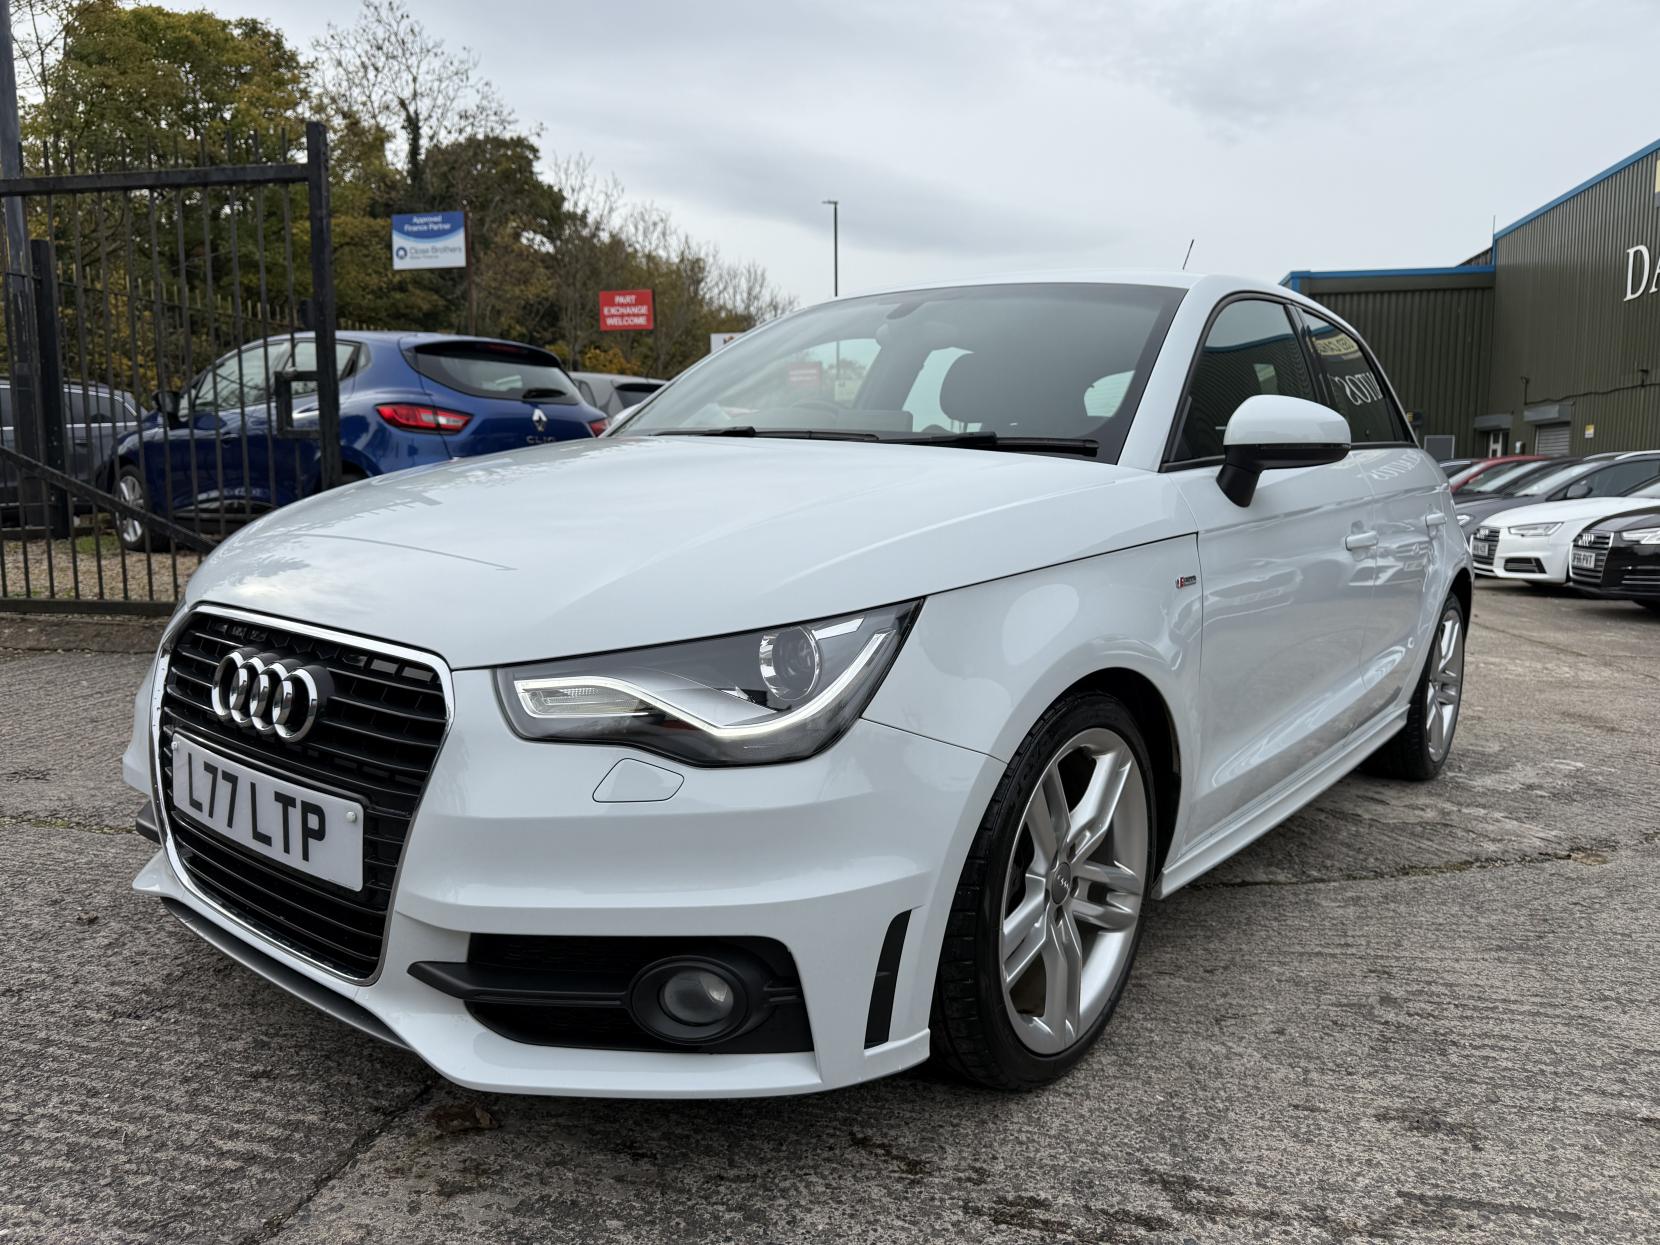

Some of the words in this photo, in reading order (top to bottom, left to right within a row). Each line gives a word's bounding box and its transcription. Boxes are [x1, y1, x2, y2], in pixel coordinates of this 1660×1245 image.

[413, 214, 443, 224] Approved
[404, 224, 428, 233] Finance
[429, 222, 452, 232] Partner
[614, 294, 637, 305] PART
[603, 304, 648, 315] EXCHANGE
[606, 315, 648, 326] WELCOME
[187, 752, 239, 829] L77
[250, 781, 326, 862] LTP
